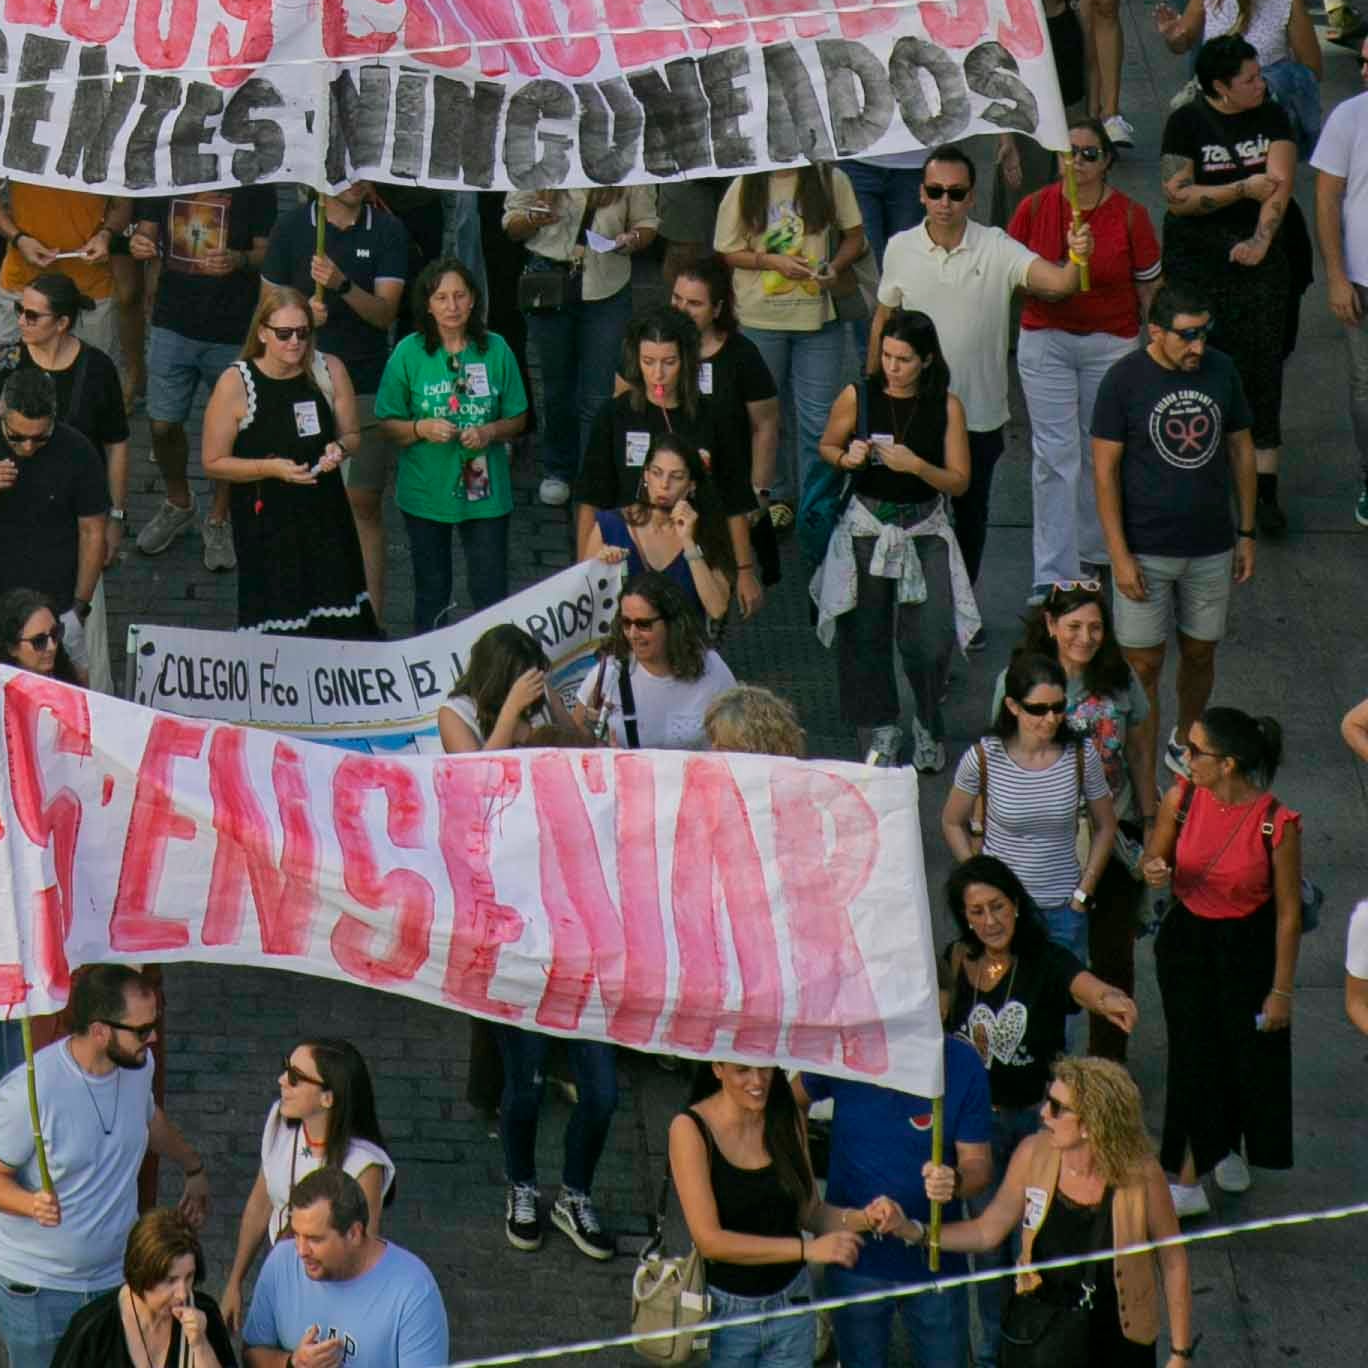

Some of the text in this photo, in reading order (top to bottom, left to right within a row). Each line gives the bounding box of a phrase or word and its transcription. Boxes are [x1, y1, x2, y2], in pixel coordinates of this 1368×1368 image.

[325, 34, 1040, 190] NINGUNEADOS
[159, 652, 247, 702] COLEGIO
[314, 666, 402, 707] GINER
